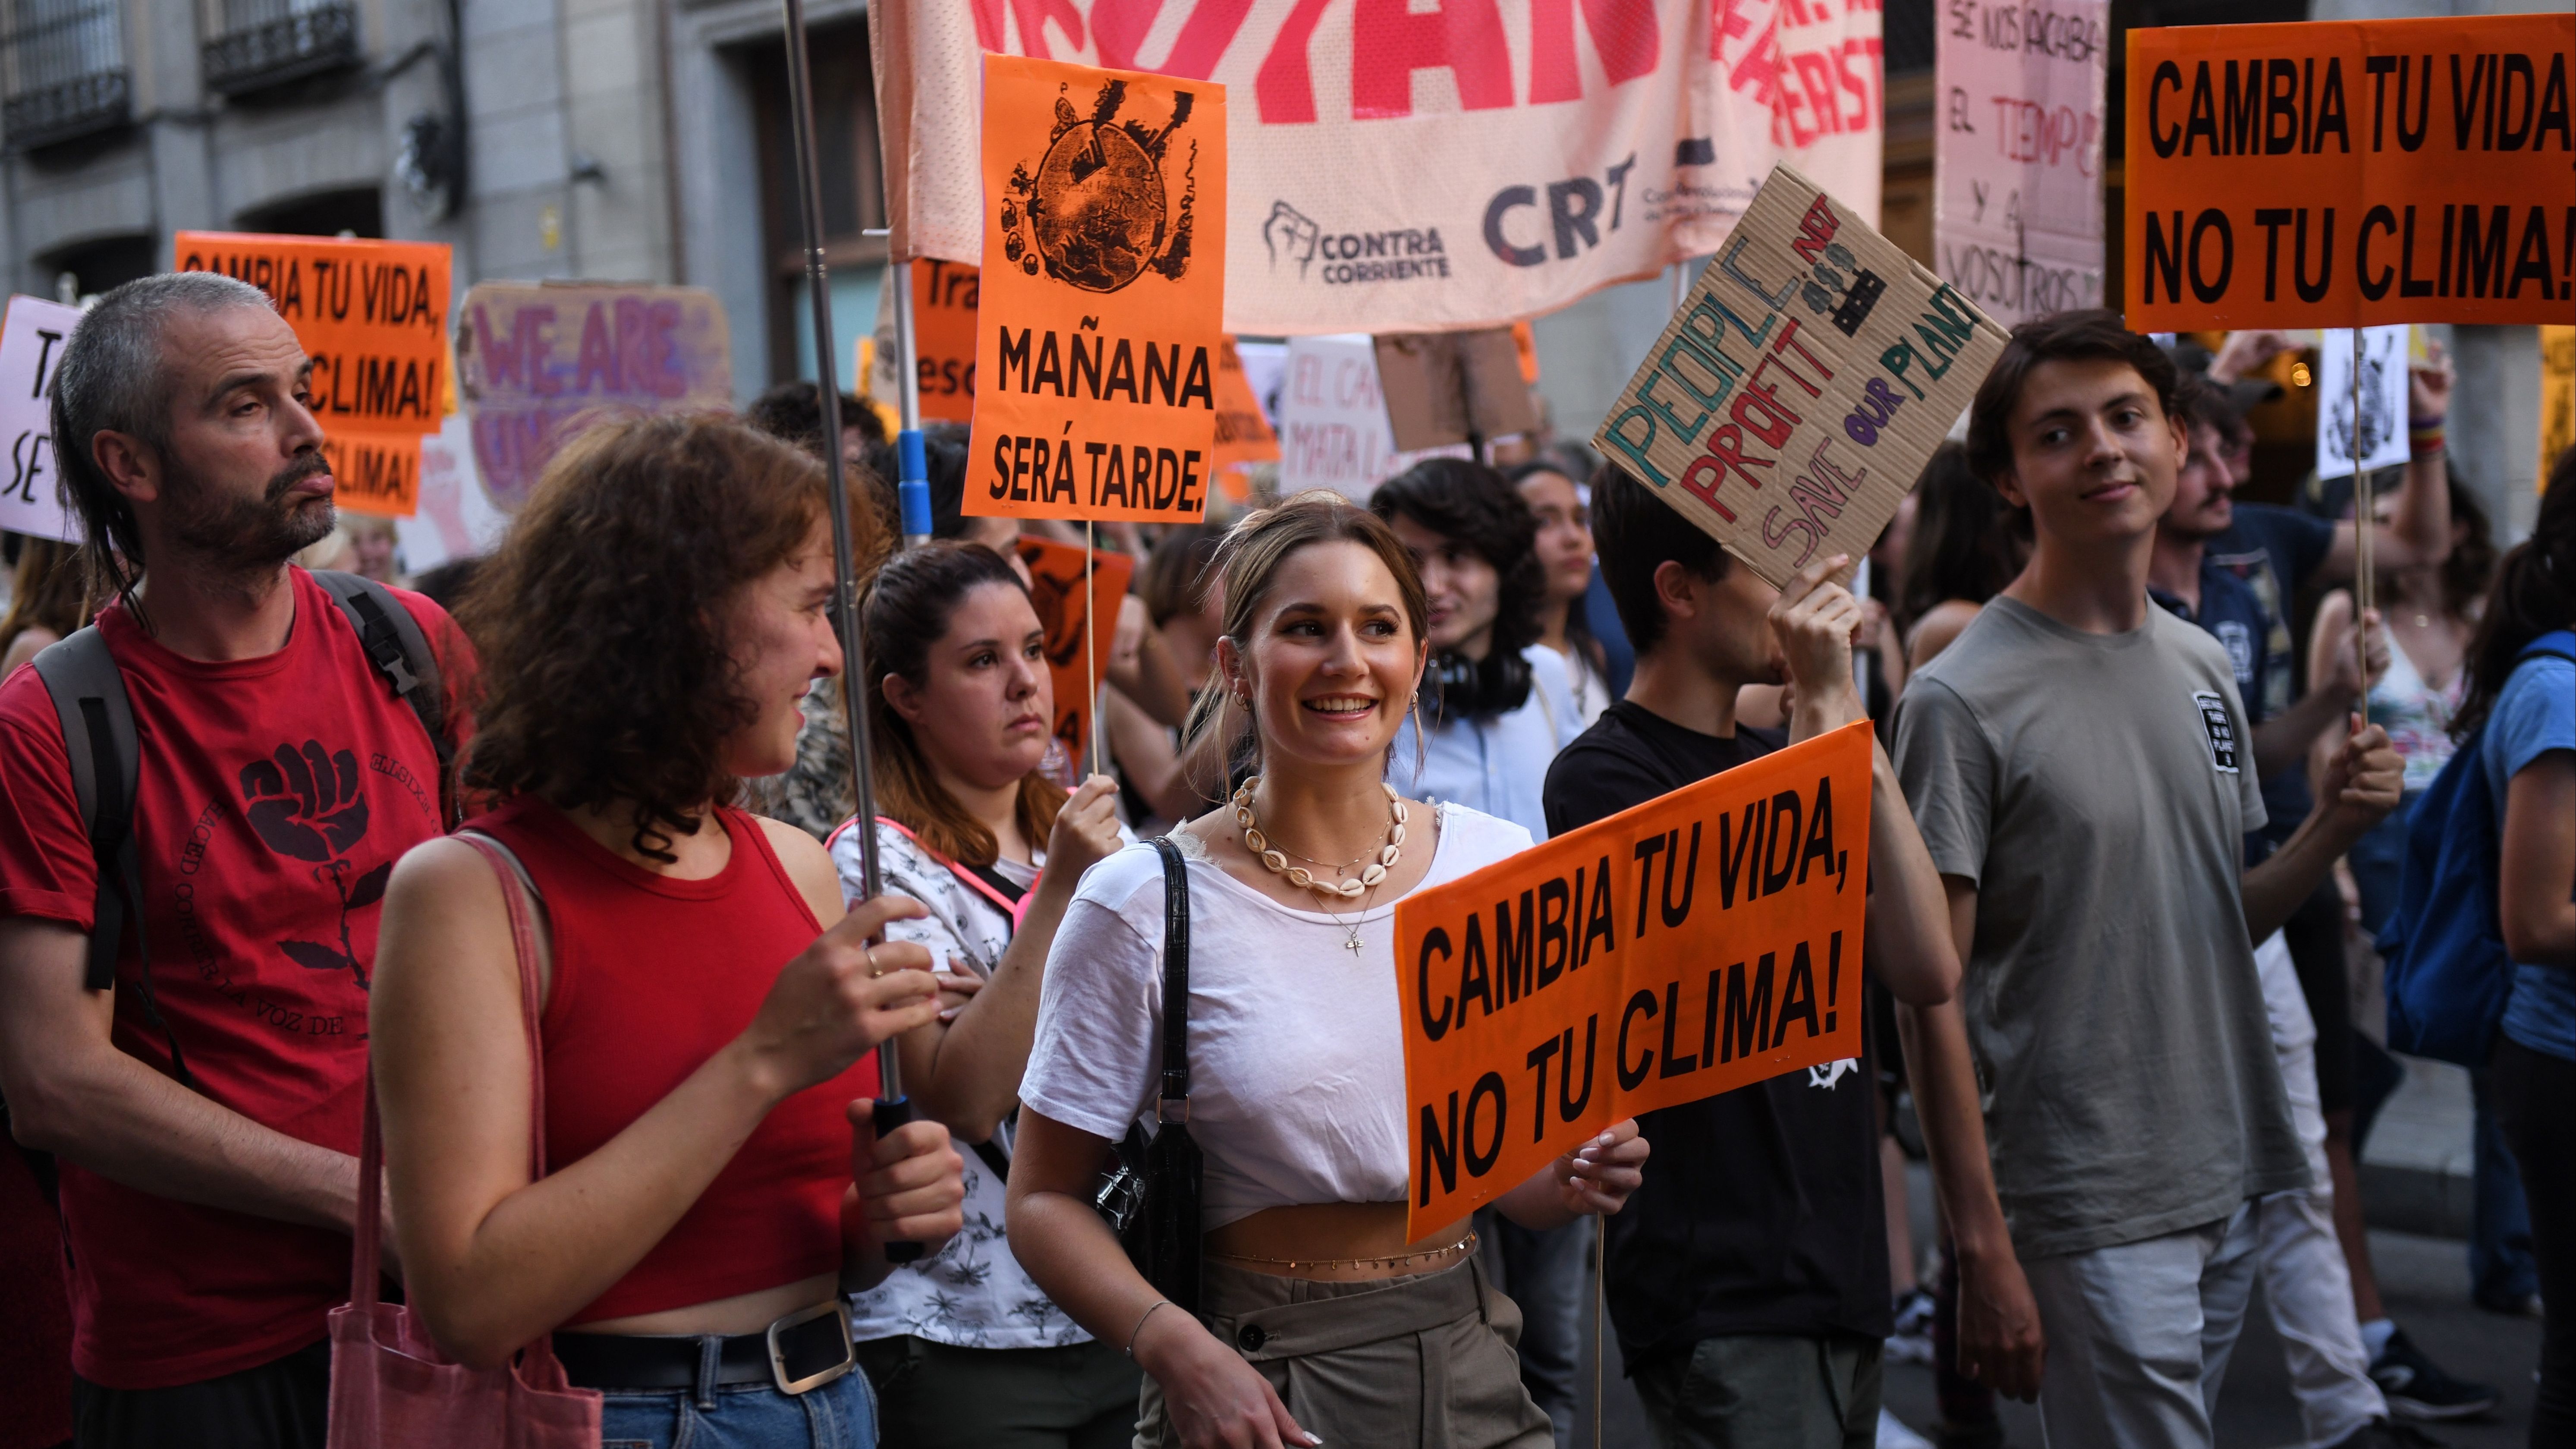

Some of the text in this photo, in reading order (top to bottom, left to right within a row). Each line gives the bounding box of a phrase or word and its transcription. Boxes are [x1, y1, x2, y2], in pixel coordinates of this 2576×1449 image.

[2149, 53, 2576, 159] CAMBIA TU VIDA
[1321, 227, 1444, 260] CONTRA
[1483, 152, 1636, 267] CRT
[1792, 192, 1840, 265] NOT
[2144, 205, 2576, 305] NO TU CLIMA!
[314, 258, 352, 321] TU
[362, 261, 439, 340] VIDA,
[1323, 257, 1450, 284] CORRIENTE
[311, 350, 435, 419] CLIMA!
[472, 296, 688, 398] WE ARE
[999, 315, 1214, 410] MAÑANA
[1294, 353, 1324, 407] EL
[989, 420, 1202, 513] SERÁ TARDE.
[1680, 316, 1834, 524] PROFIT
[321, 437, 415, 506] LIMA!
[1762, 437, 1867, 569] SAVE
[1843, 377, 1906, 447] OUR
[173, 795, 344, 1035] HACED CORRER LA VOZ DE
[1418, 776, 1848, 1042] CAMBIA TU VIDA,
[1419, 930, 1843, 1208] NO TU CLIMA!
